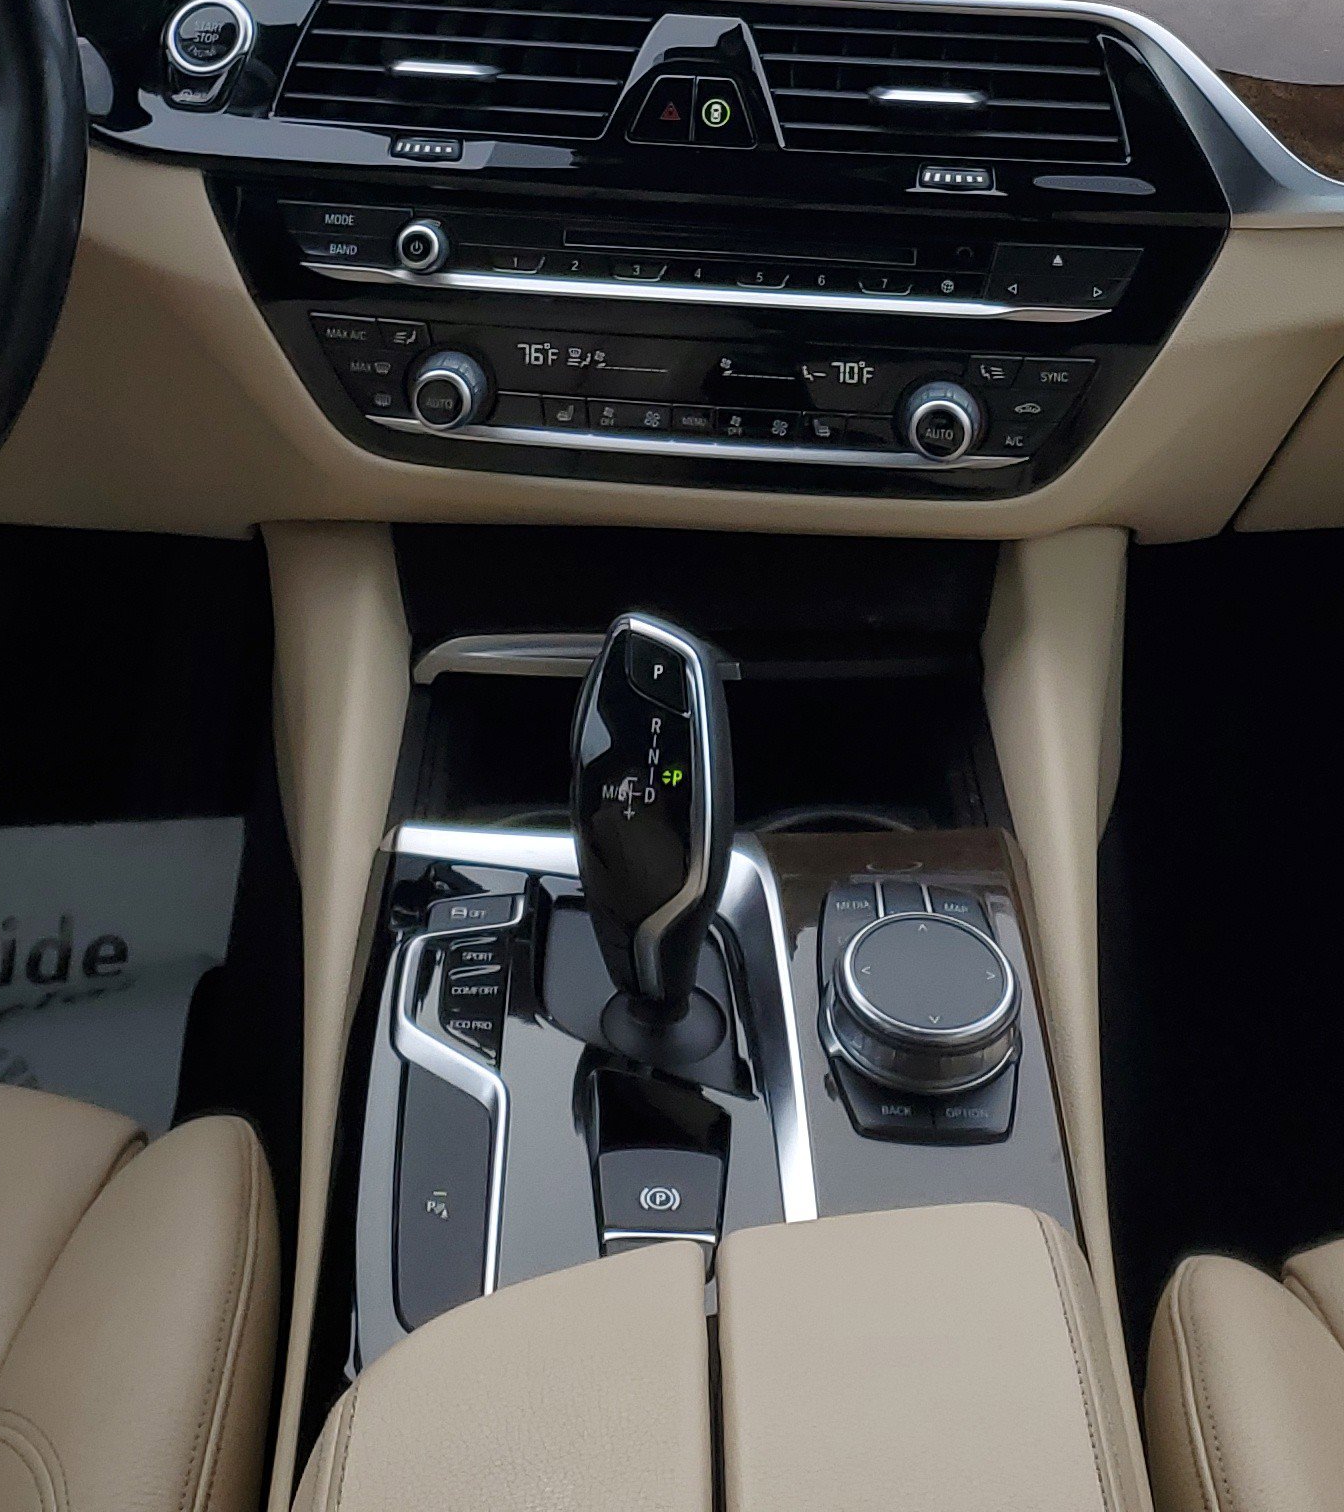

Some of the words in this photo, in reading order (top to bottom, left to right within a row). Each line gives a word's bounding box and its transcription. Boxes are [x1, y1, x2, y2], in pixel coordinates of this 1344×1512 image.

[193, 32, 220, 43] STOP
[324, 213, 355, 227] MODE
[329, 243, 358, 255] BAND
[512, 257, 518, 267] 1
[571, 260, 579, 271] 2
[633, 264, 641, 276] 3
[693, 268, 702, 279] 4
[756, 272, 764, 283] 5
[817, 275, 826, 286] 6
[880, 278, 888, 289] 7
[517, 342, 560, 366] 76°F
[830, 360, 875, 385] 70°F
[1040, 371, 1069, 383] SYNC
[925, 427, 954, 439] AUTO
[1005, 436, 1023, 447] A/C
[653, 664, 664, 680] P
[651, 717, 662, 734] R
[648, 748, 660, 765] N
[672, 770, 683, 787] P
[644, 787, 656, 804] D
[462, 951, 493, 962] SPORT
[451, 986, 499, 996] COMFORT
[472, 1021, 493, 1031] PRO
[881, 1105, 913, 1117] BACK
